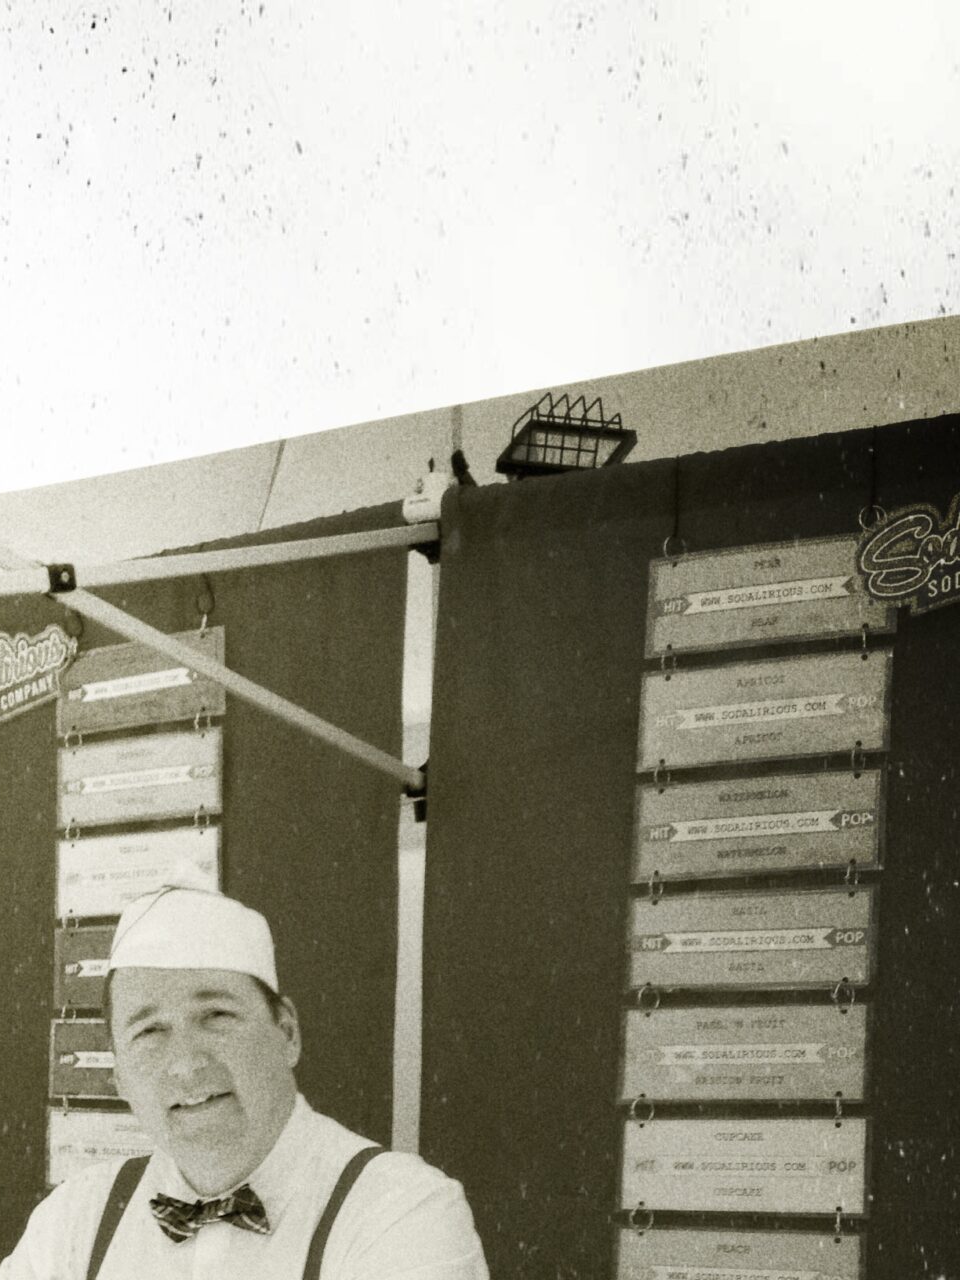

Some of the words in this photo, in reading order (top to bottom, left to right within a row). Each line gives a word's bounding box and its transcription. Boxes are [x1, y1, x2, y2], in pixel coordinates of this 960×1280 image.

[0, 672, 54, 711] COMPANY
[841, 811, 870, 826] POP
[835, 931, 864, 944] POP
[714, 1132, 764, 1142] CUPCAKE
[827, 1160, 858, 1173] POP
